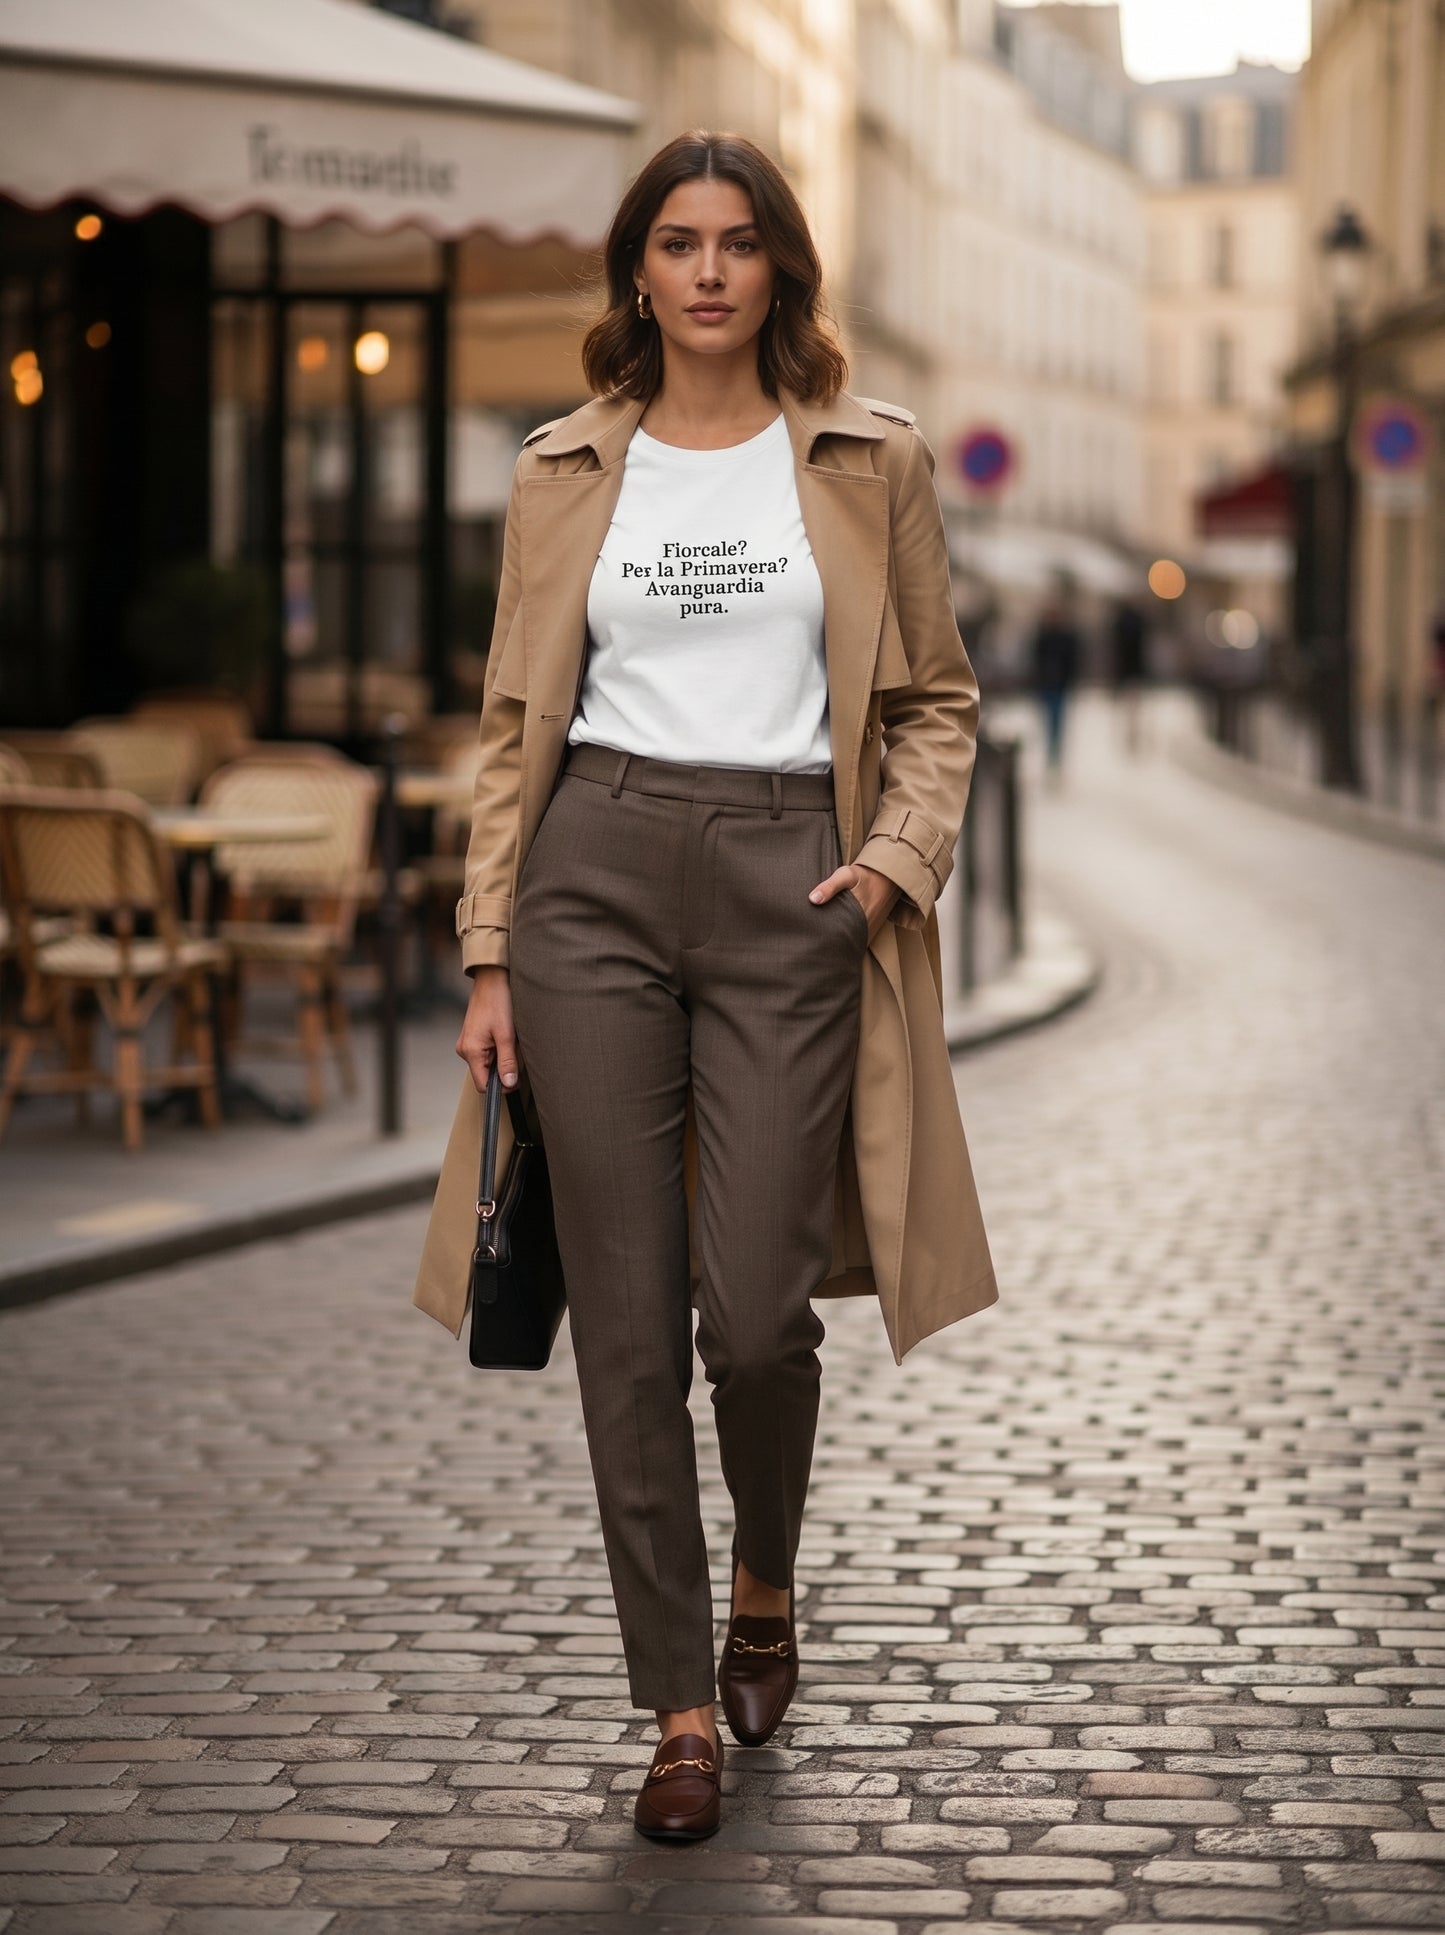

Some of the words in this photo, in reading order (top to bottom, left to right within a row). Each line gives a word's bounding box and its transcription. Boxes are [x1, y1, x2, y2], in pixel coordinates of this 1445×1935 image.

[662, 540, 748, 558] Fiorcale?
[621, 562, 652, 578] Per
[657, 561, 675, 578] la
[680, 557, 788, 577] Primavera?
[645, 577, 765, 600] Avanguardia
[679, 602, 729, 620] pura.
